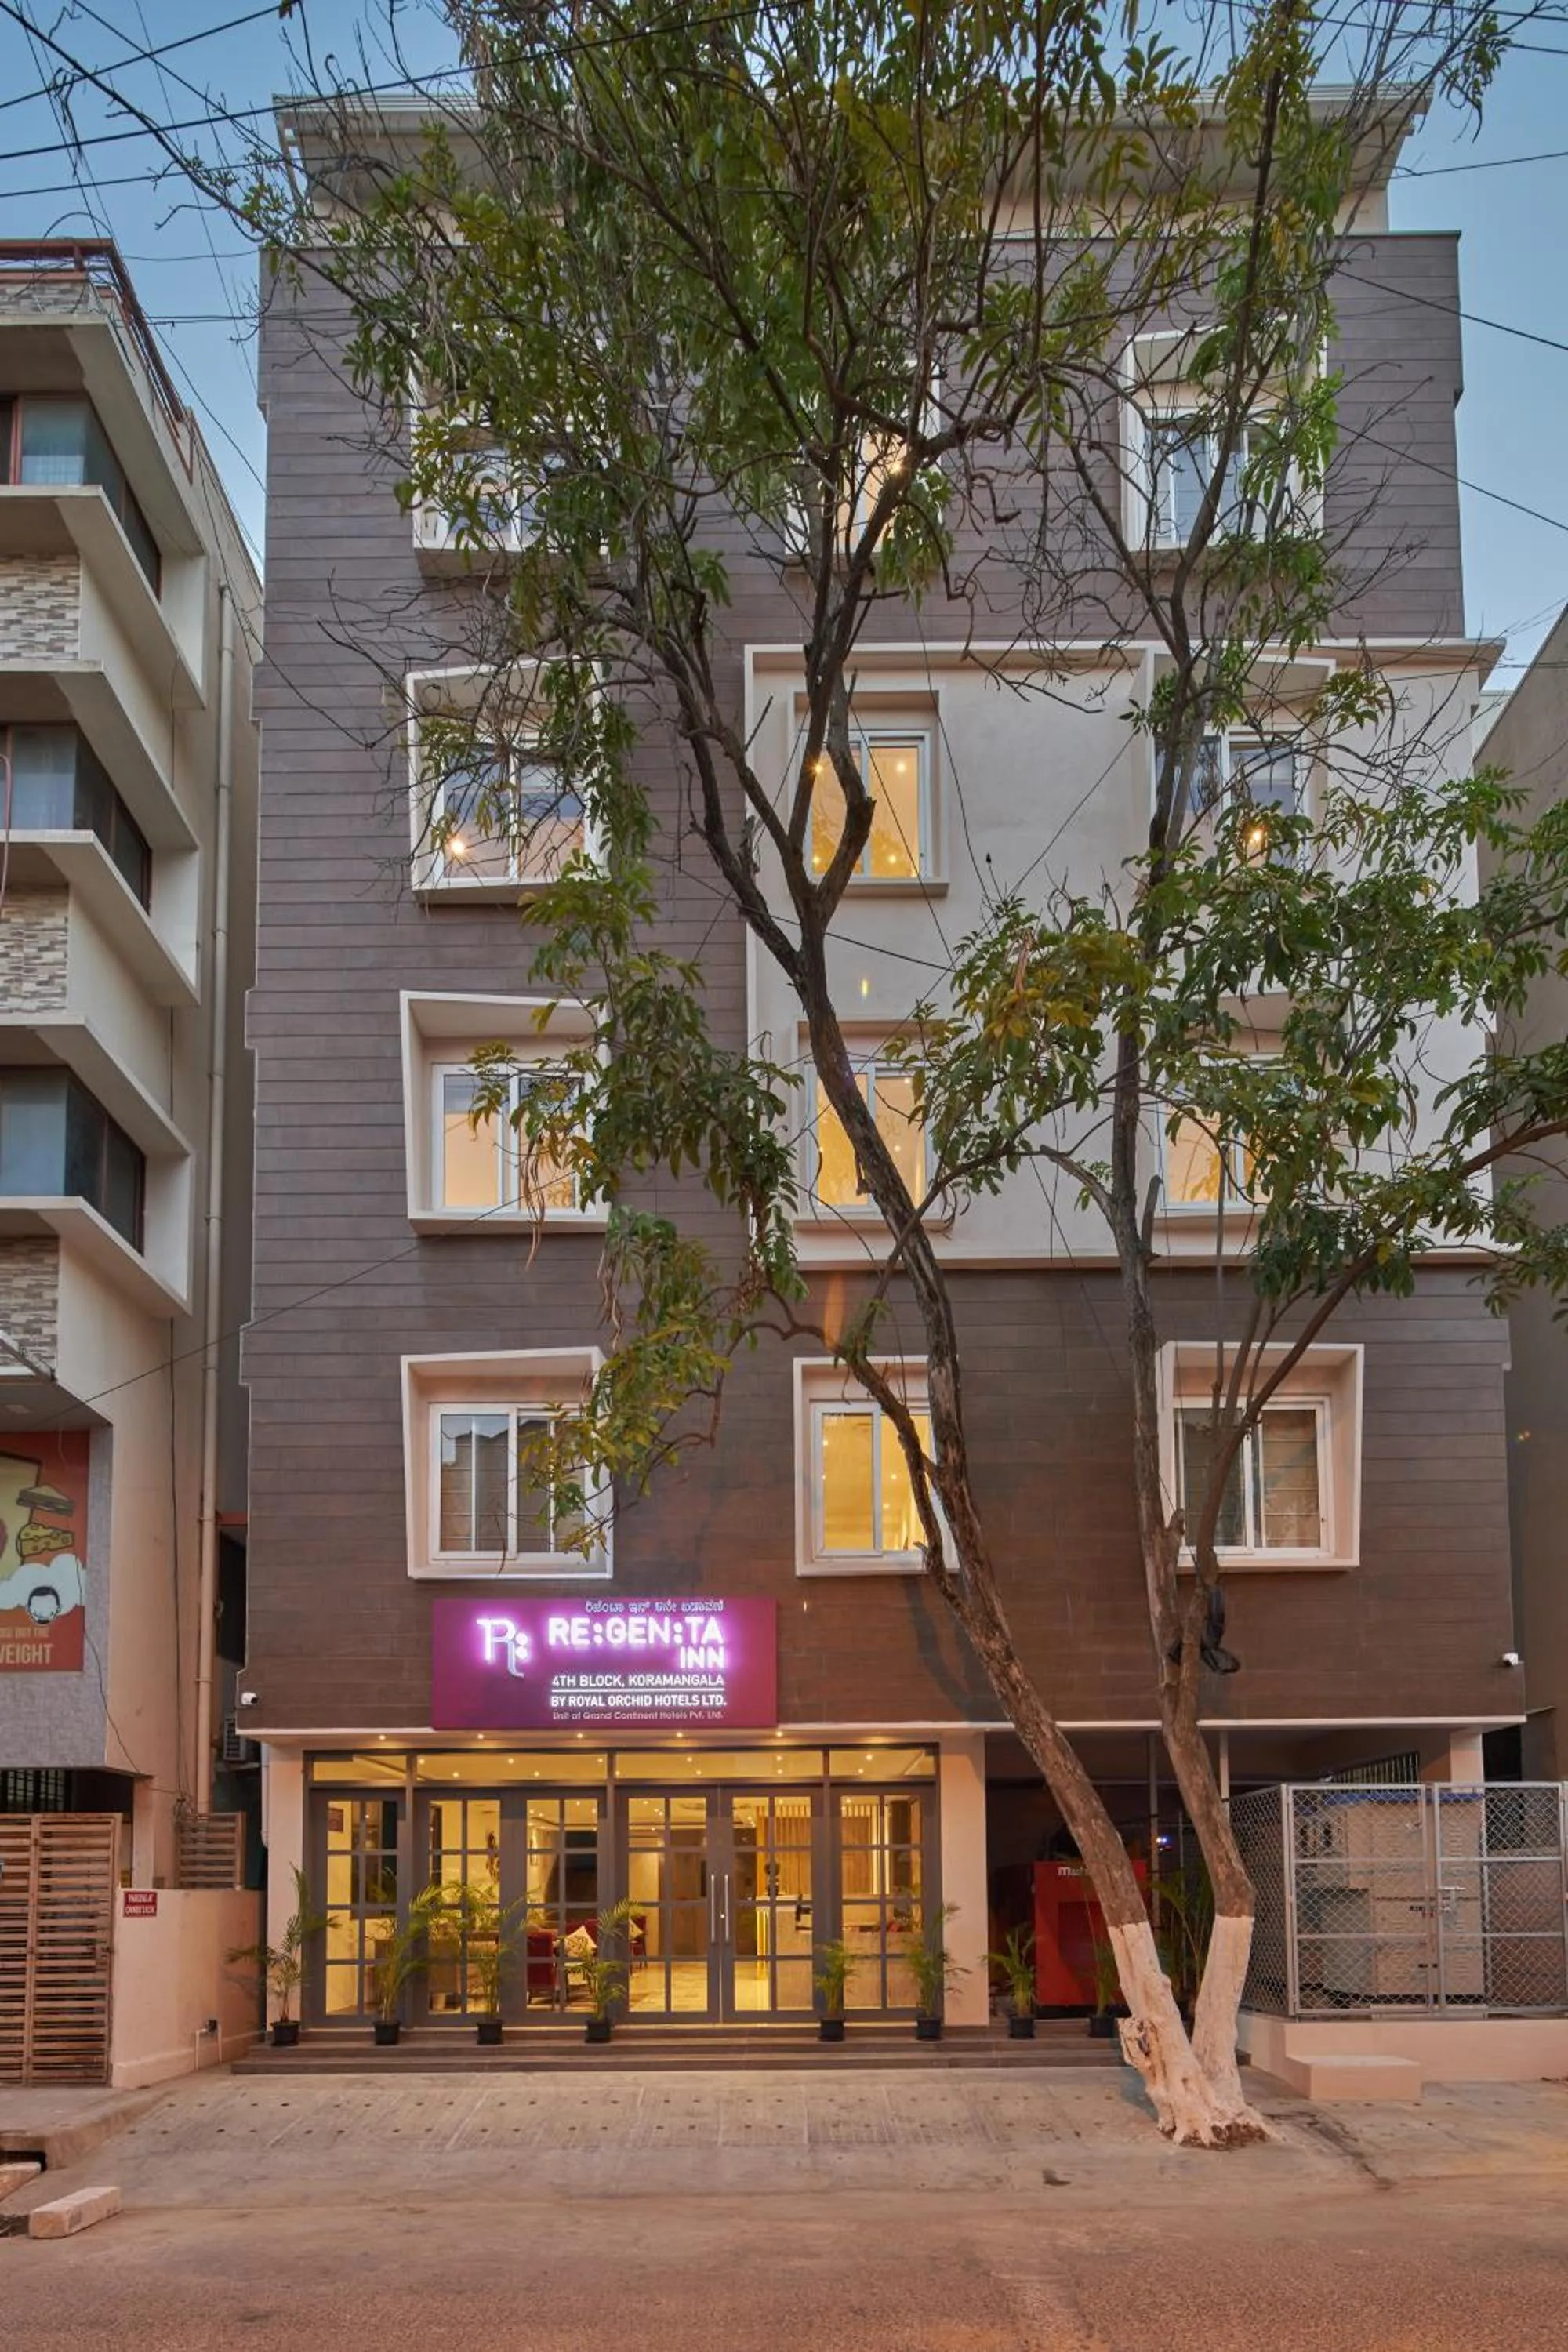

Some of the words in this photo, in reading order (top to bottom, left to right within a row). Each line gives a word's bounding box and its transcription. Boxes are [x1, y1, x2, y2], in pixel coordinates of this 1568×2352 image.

[680, 1646, 724, 1669] INN
[552, 1675, 576, 1687] 4TH
[580, 1674, 625, 1688] BLOCK,
[628, 1674, 724, 1686] KORAMANGALA
[551, 1696, 565, 1707] BY
[568, 1695, 605, 1707] ROYAL
[608, 1695, 652, 1706] ORCHID
[655, 1694, 700, 1706] HOTELS
[702, 1694, 728, 1706] LTD.
